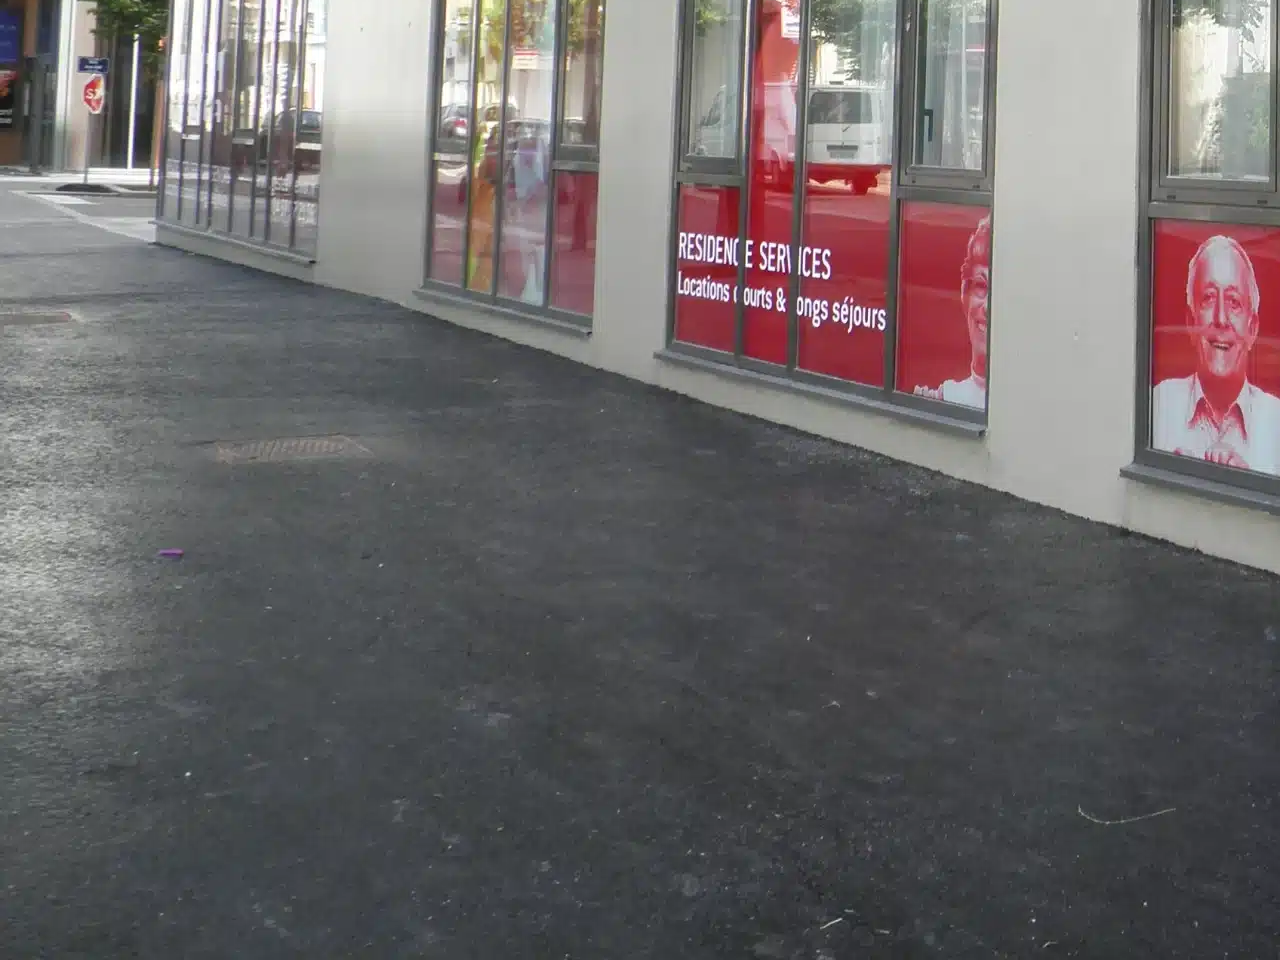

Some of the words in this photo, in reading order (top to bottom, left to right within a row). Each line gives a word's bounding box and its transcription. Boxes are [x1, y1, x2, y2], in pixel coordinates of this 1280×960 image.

[678, 271, 730, 303] Locations
[776, 287, 787, 313] &
[796, 296, 829, 328] ongs
[832, 296, 887, 334] séjours
